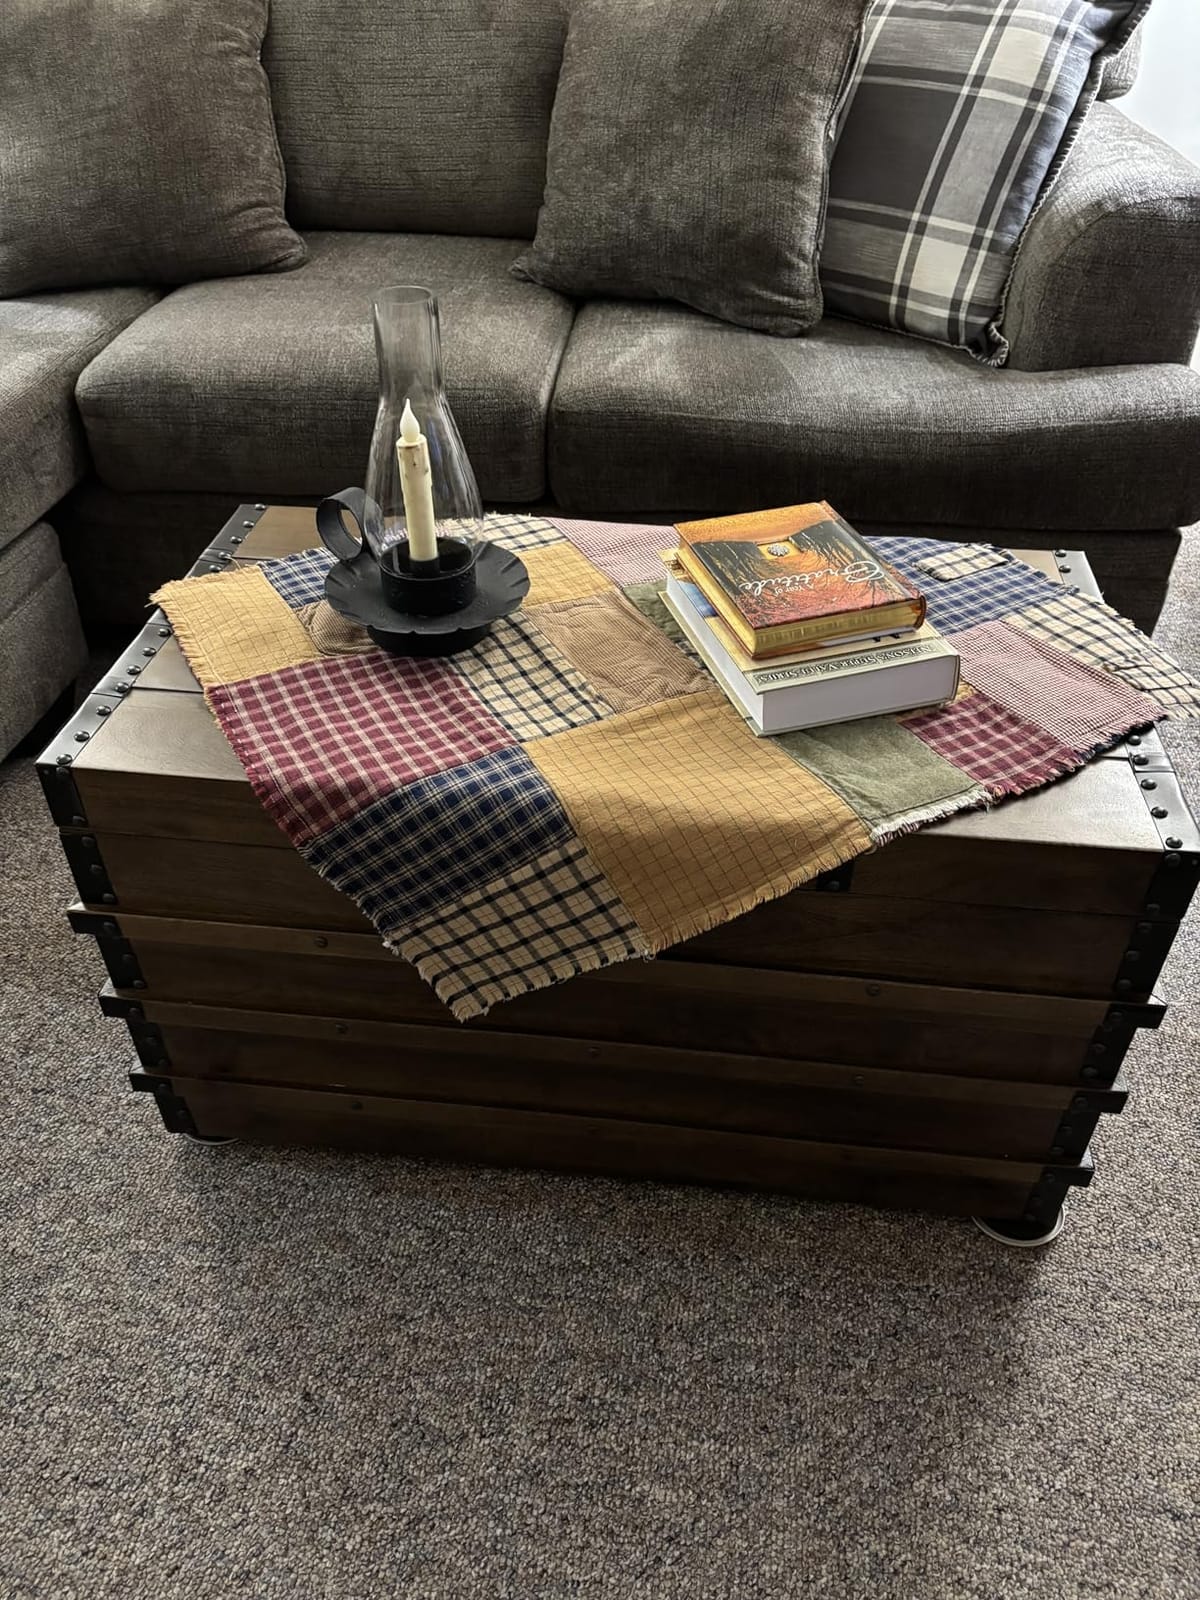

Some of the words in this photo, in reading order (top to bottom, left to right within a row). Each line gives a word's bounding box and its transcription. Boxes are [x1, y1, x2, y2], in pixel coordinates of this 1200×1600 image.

[738, 560, 885, 597] Gratitude
[774, 586, 783, 597] of
[785, 585, 805, 593] Year
[877, 644, 932, 661] NELSON'S
[839, 655, 877, 668] SUPER
[801, 663, 839, 675] VALUE
[760, 670, 798, 682] SERIES
